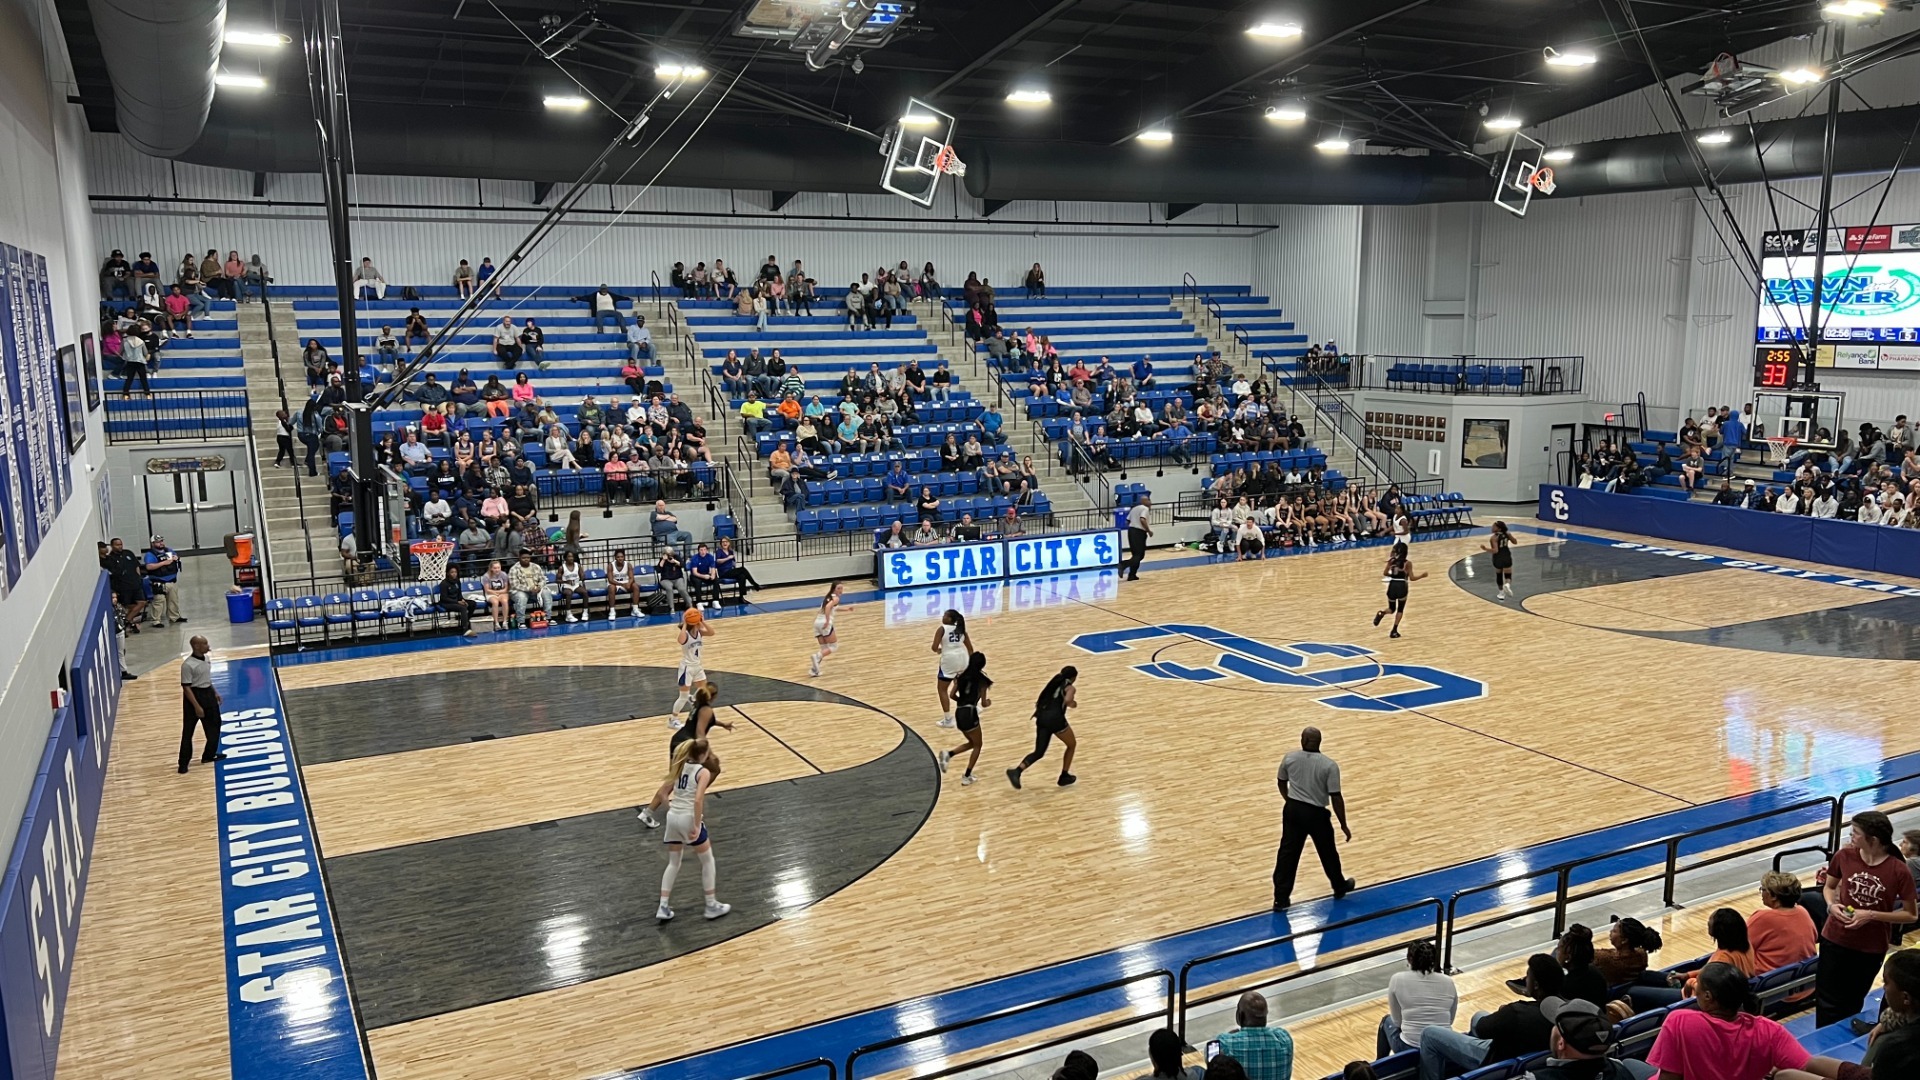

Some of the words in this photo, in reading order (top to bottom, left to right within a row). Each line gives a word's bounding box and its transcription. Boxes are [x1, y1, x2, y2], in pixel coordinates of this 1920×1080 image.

[1767, 277, 1870, 291] LAWN
[1768, 291, 1896, 304] POWER
[1767, 350, 1790, 362] 2:55
[1837, 351, 1868, 360] Relyance
[1762, 364, 1787, 385] 33
[1551, 490, 1569, 520] SC
[891, 553, 913, 585] SC
[925, 546, 997, 581] STAR
[1015, 538, 1082, 572] CITY
[1093, 534, 1113, 564] SC
[1611, 542, 1715, 561] STAR
[1722, 560, 1831, 578] CITY
[949, 632, 960, 642] 23
[220, 708, 295, 813] BULLDOGS
[30, 748, 85, 1038] STAR
[87, 610, 116, 769] CITY
[227, 819, 310, 887] CITY
[234, 892, 332, 1003] STAR
